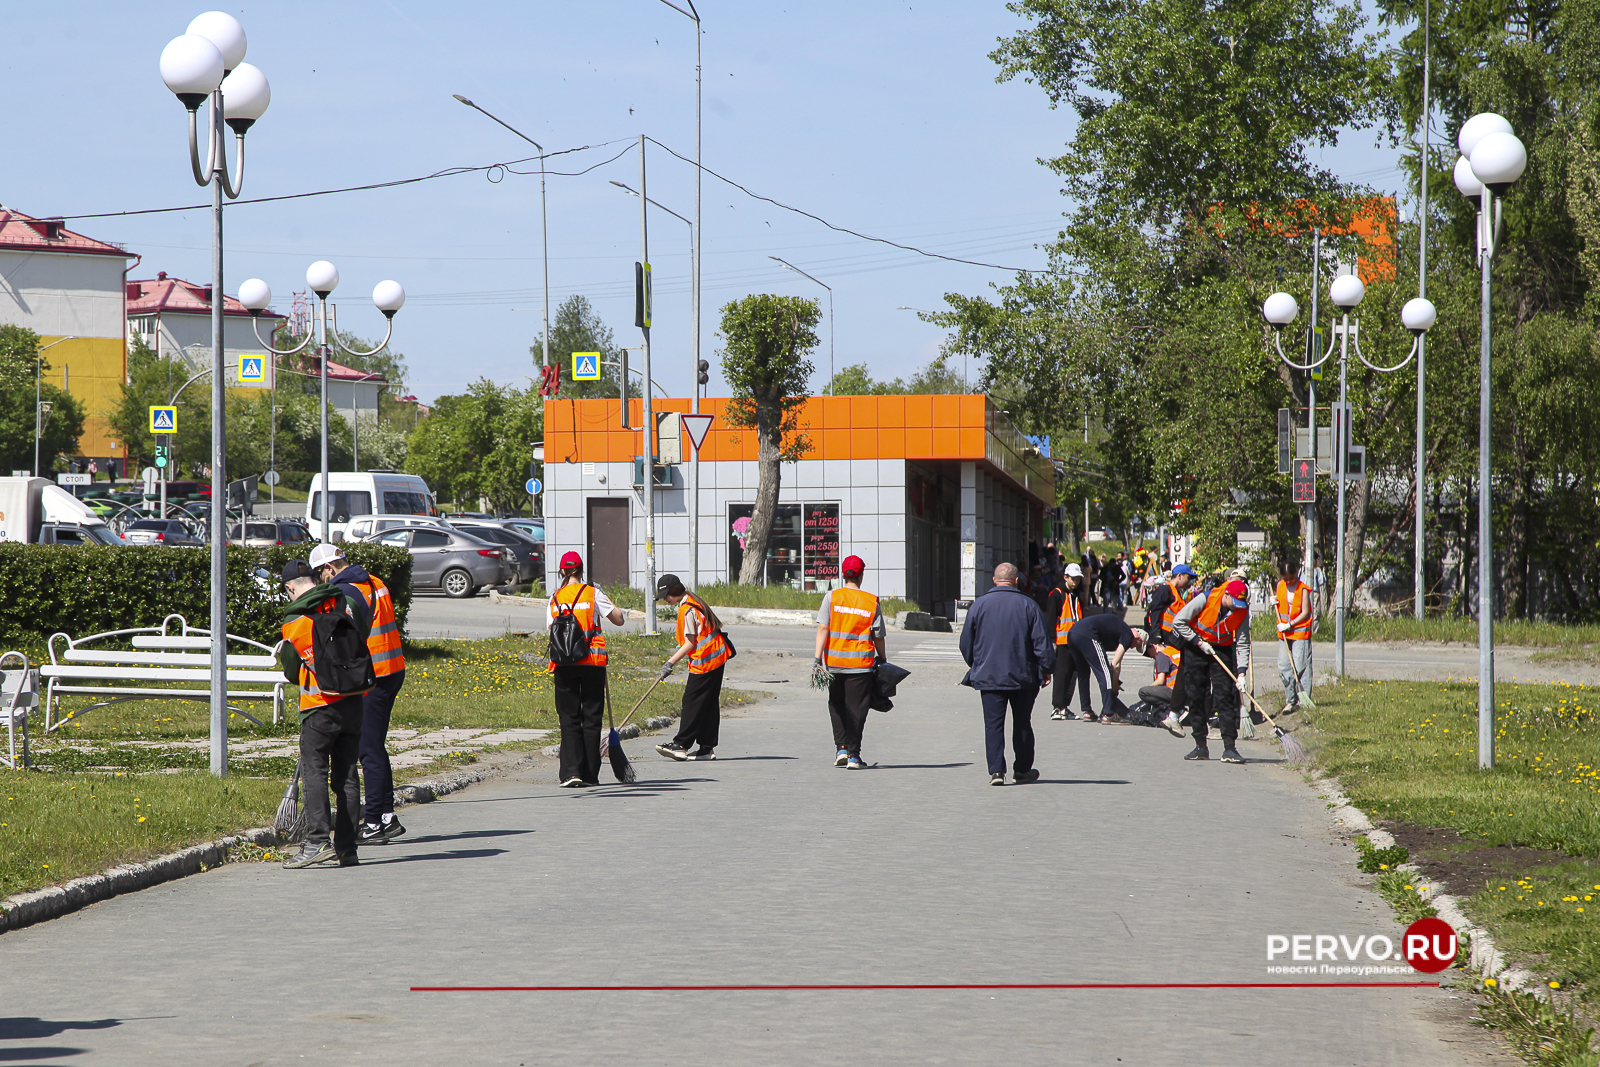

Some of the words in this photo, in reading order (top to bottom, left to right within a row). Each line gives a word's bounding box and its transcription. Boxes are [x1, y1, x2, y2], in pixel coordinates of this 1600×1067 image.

[538, 362, 561, 397] 24
[155, 446, 168, 456] 21
[1294, 482, 1314, 500] 95
[818, 517, 839, 526] 1250
[817, 541, 839, 551] 2550
[818, 566, 839, 575] 5050
